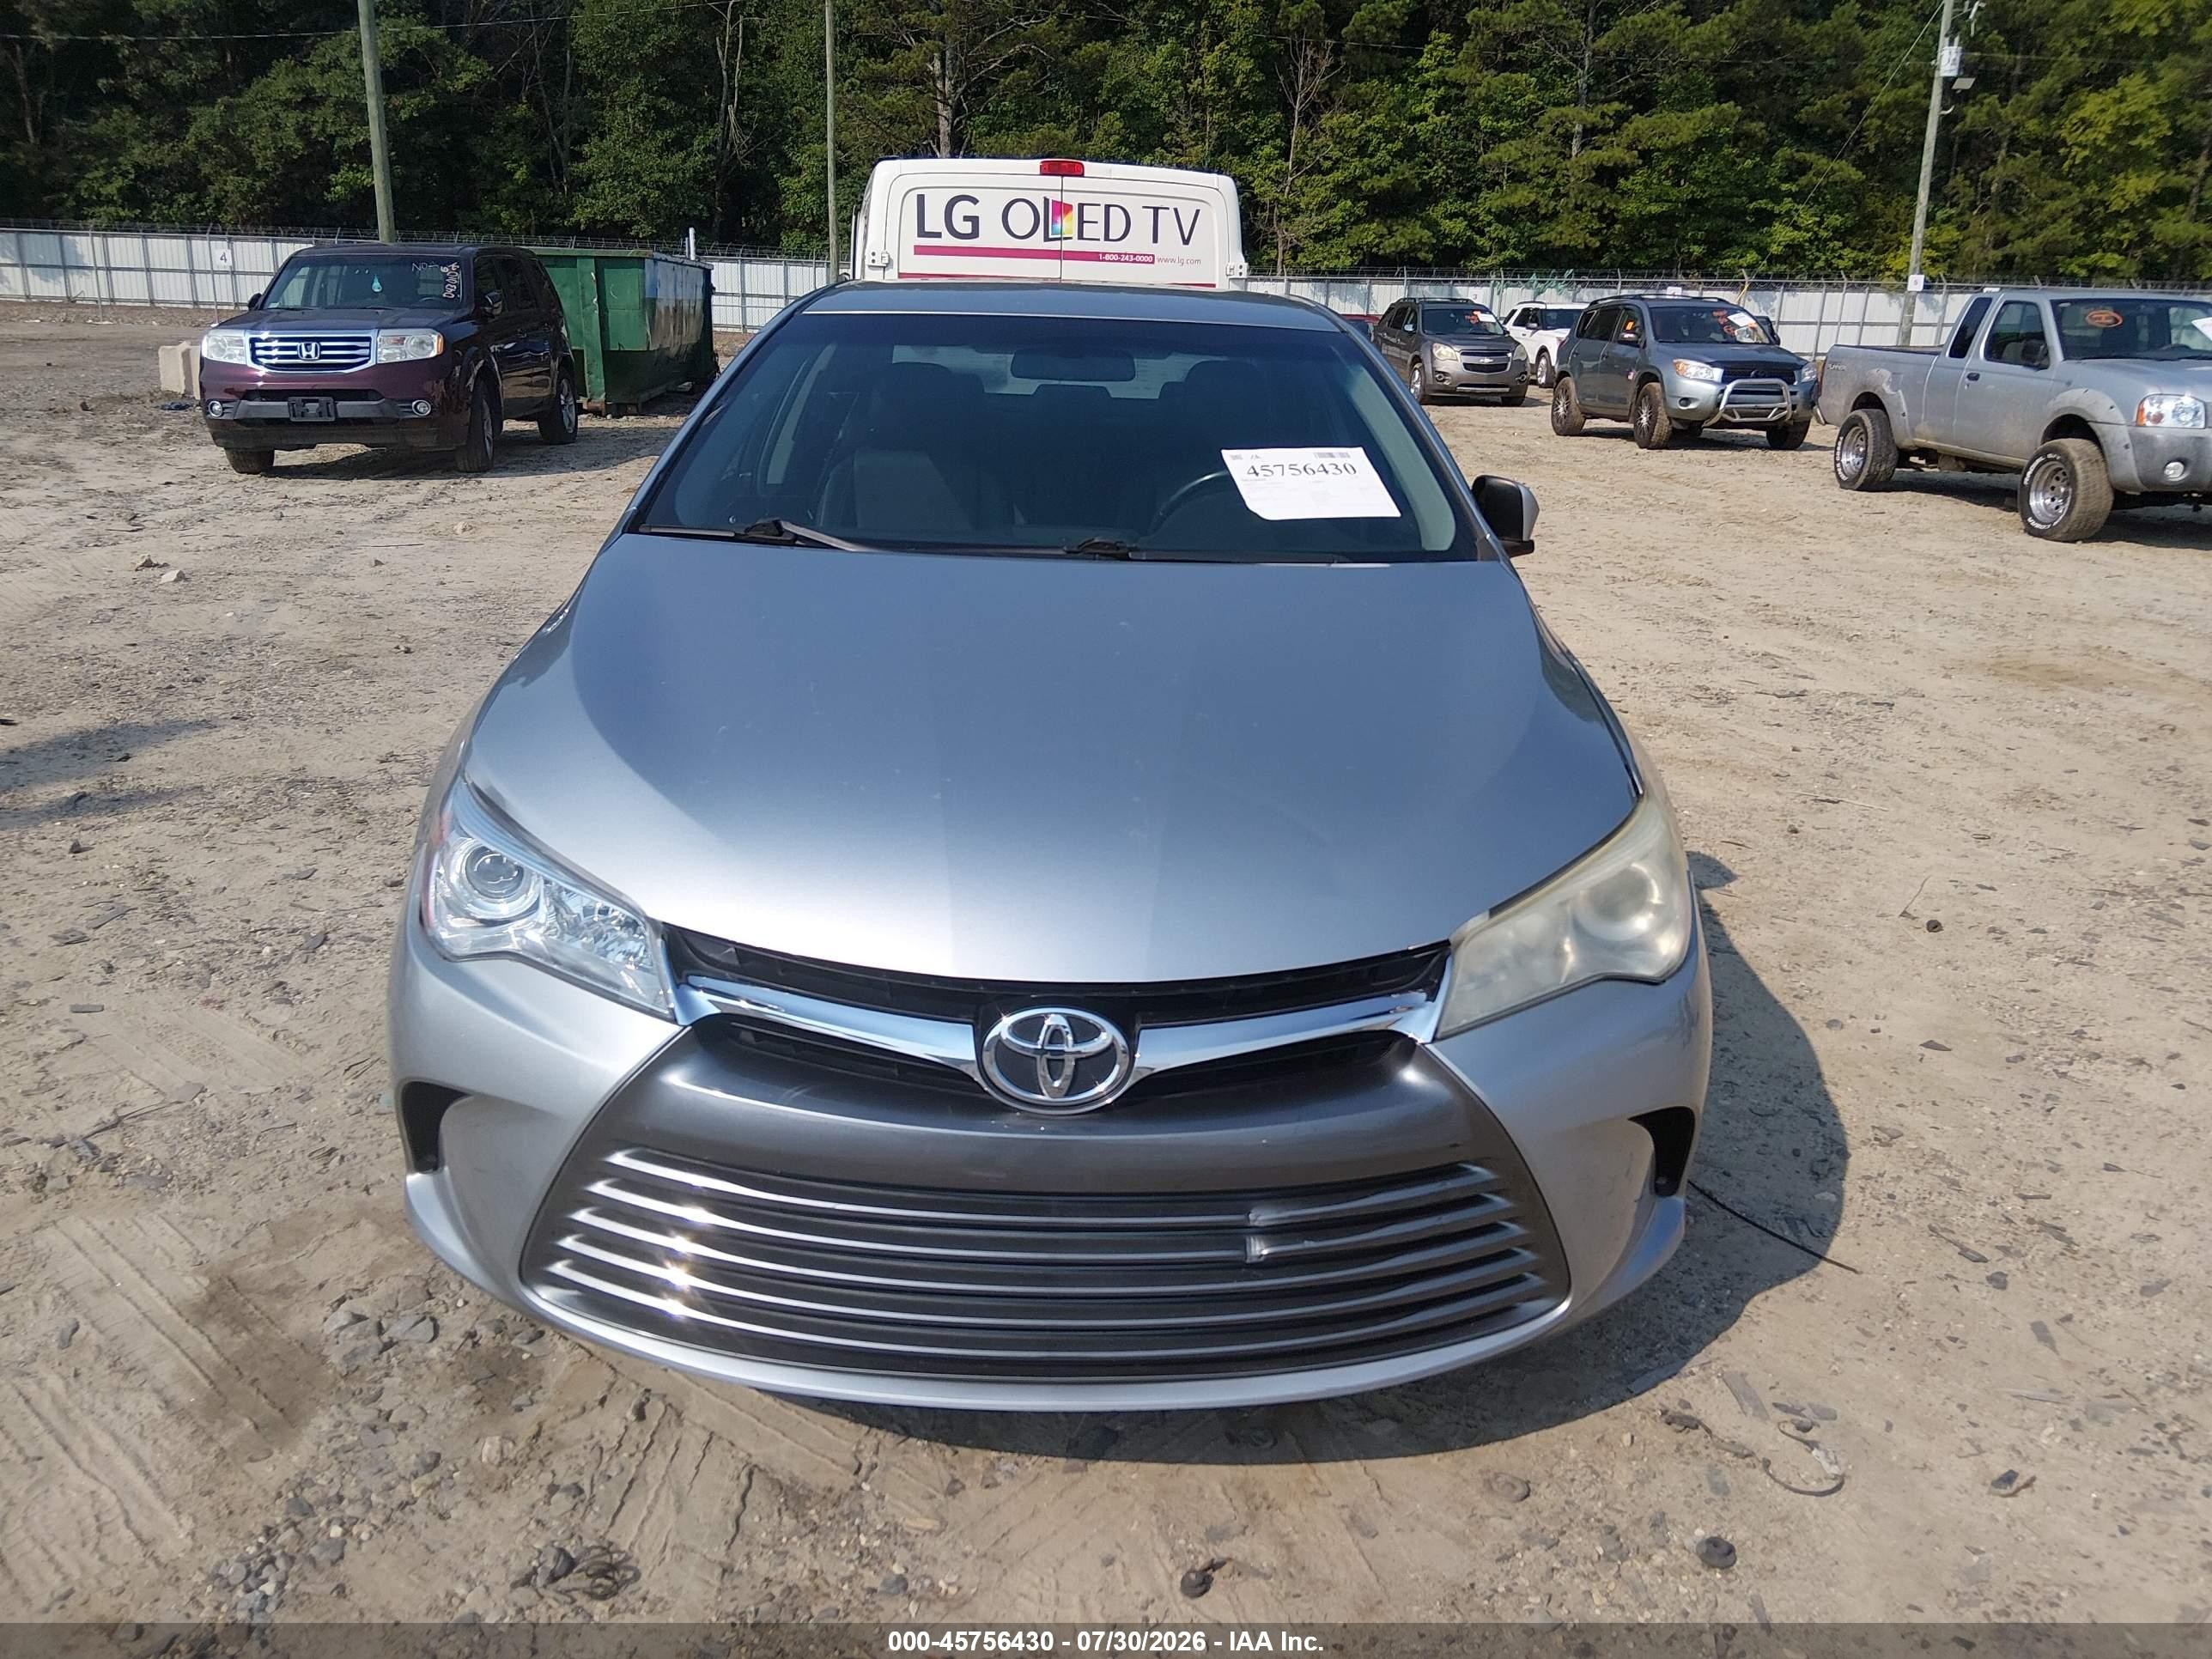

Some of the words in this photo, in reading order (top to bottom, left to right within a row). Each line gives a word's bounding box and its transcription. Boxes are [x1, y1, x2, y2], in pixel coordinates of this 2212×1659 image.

[916, 193, 981, 241] LG
[1001, 196, 1132, 244] OLED
[1142, 205, 1201, 246] TV
[220, 252, 227, 263] 4
[1099, 253, 1153, 263] 1-800-243-0000
[1157, 256, 1201, 266] www.lg.com
[1247, 463, 1357, 477] 45756430
